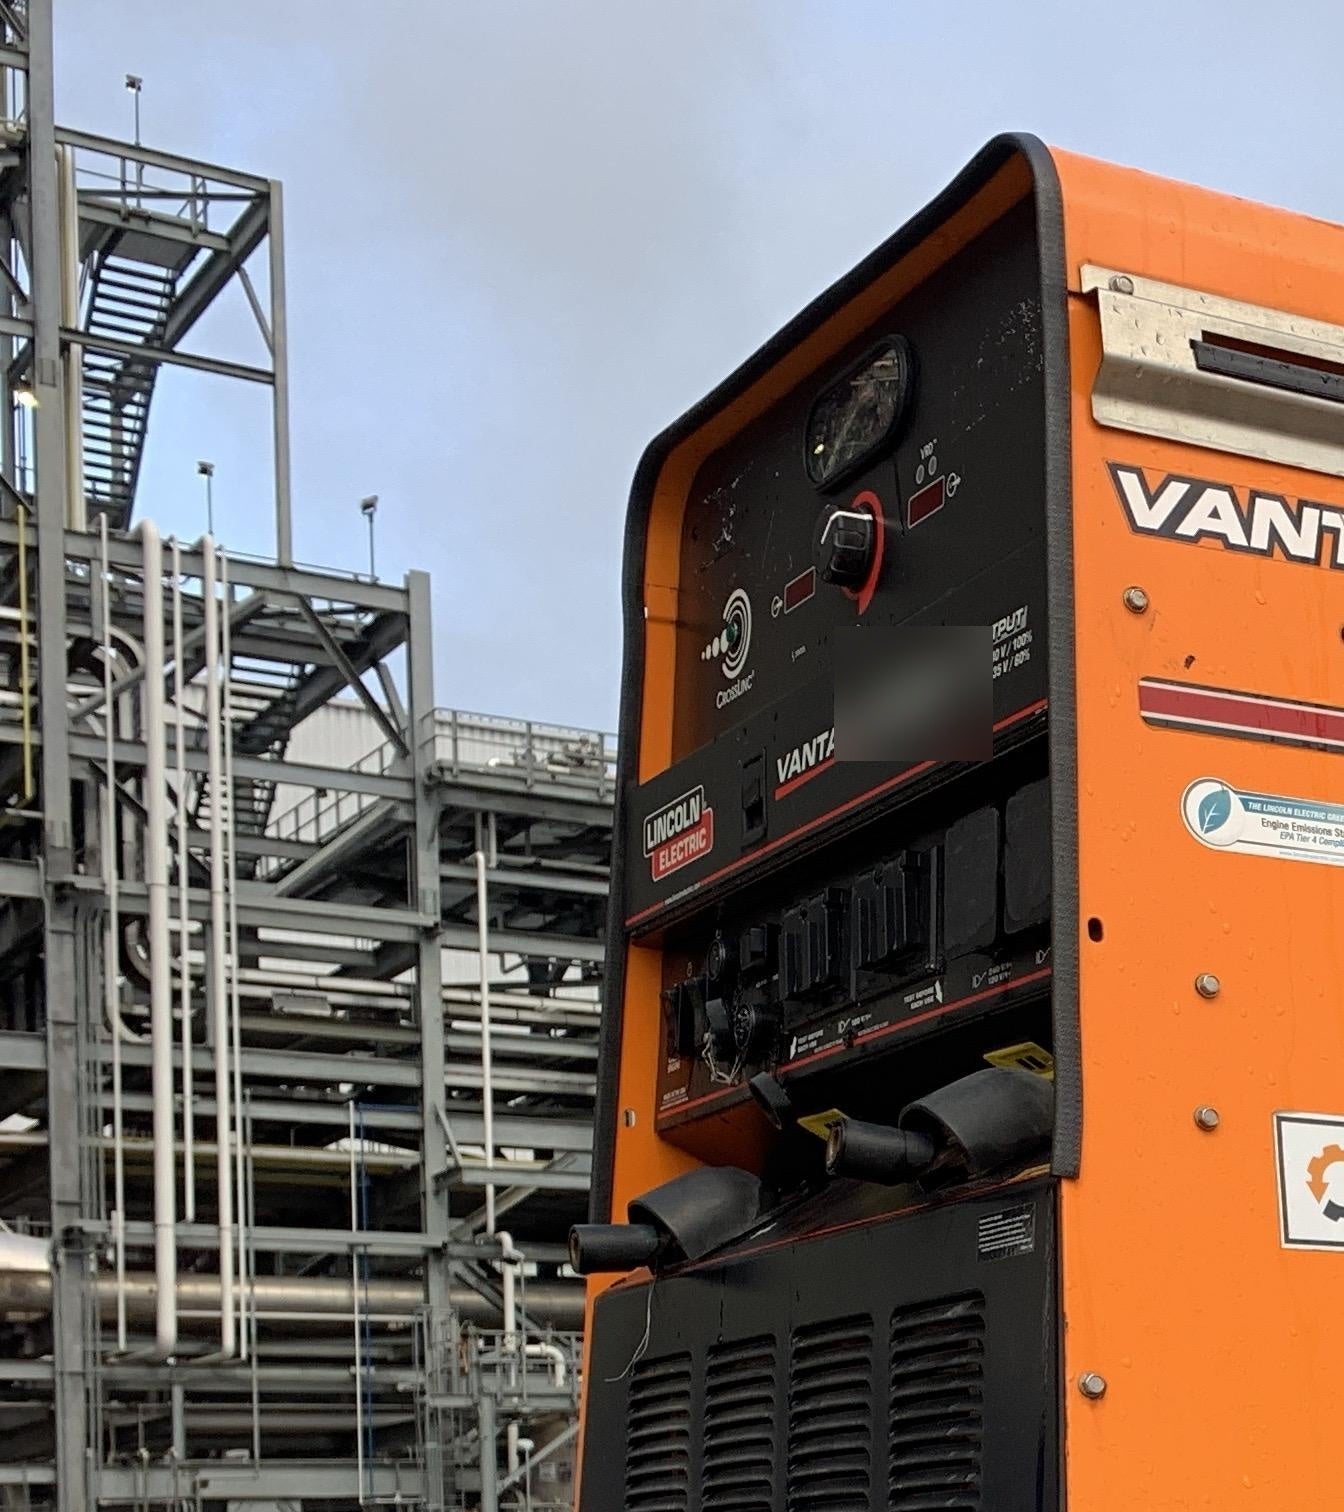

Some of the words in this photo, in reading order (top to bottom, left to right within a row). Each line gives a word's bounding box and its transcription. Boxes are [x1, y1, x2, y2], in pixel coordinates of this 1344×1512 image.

[646, 794, 701, 850] LINCOLN
[1261, 817, 1290, 832] Engine
[1292, 821, 1334, 837] Emissions
[659, 828, 707, 872] ELECTRIC
